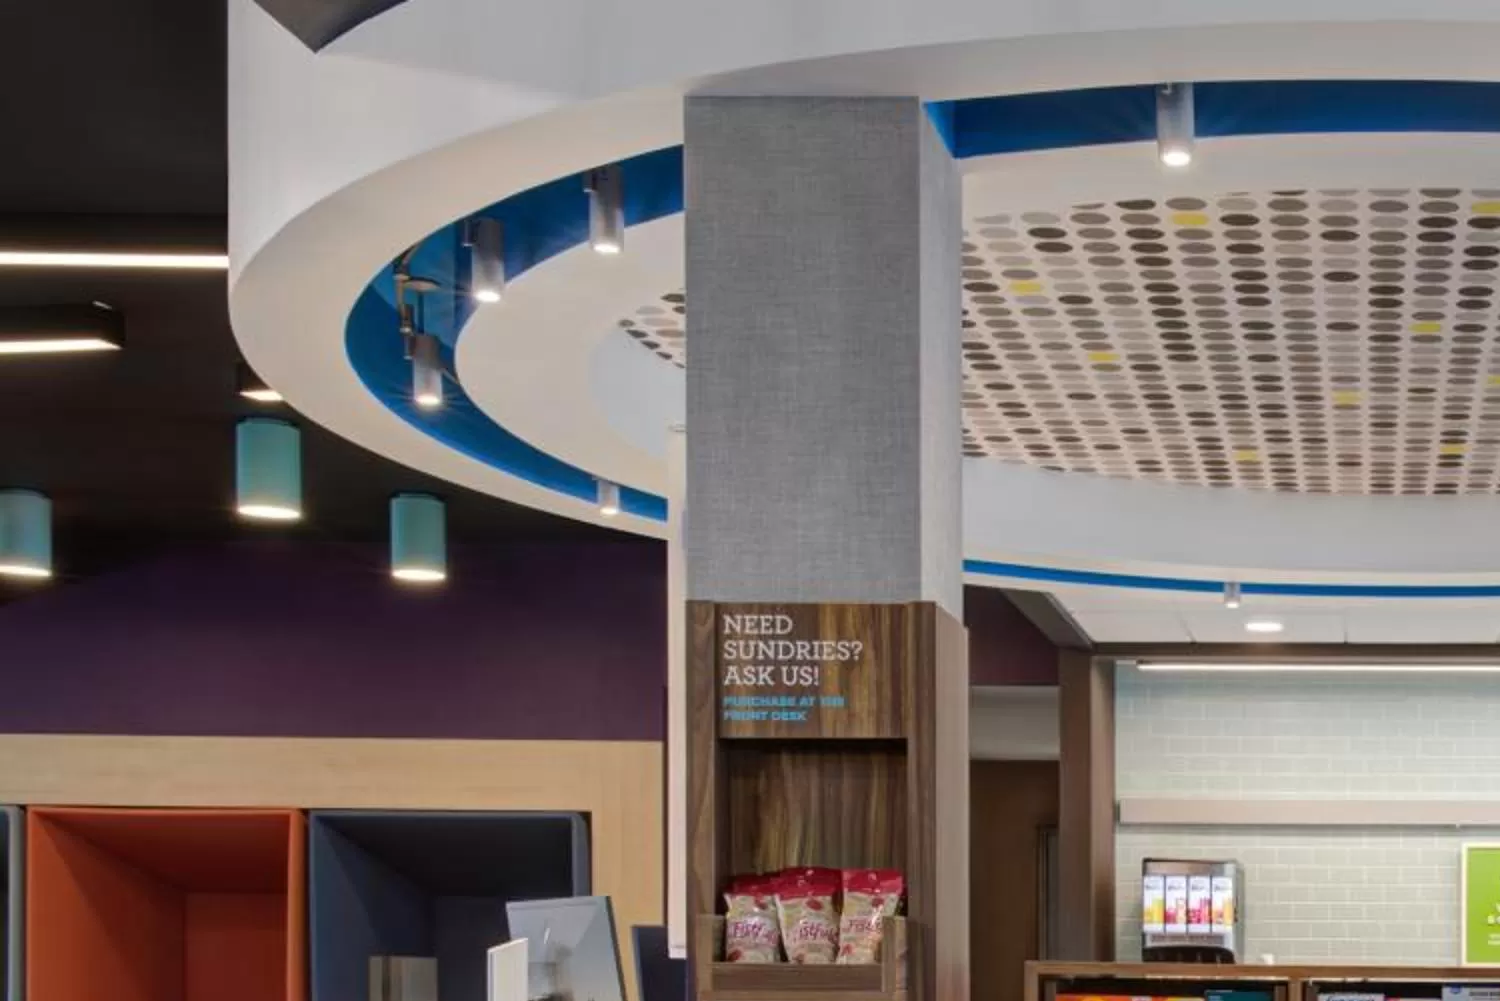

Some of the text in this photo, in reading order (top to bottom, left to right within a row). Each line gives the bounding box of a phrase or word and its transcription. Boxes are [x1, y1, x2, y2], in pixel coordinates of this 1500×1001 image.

[723, 614, 794, 636] NEED
[723, 640, 864, 661] SUNDRIES?
[723, 665, 820, 686] ASK US!
